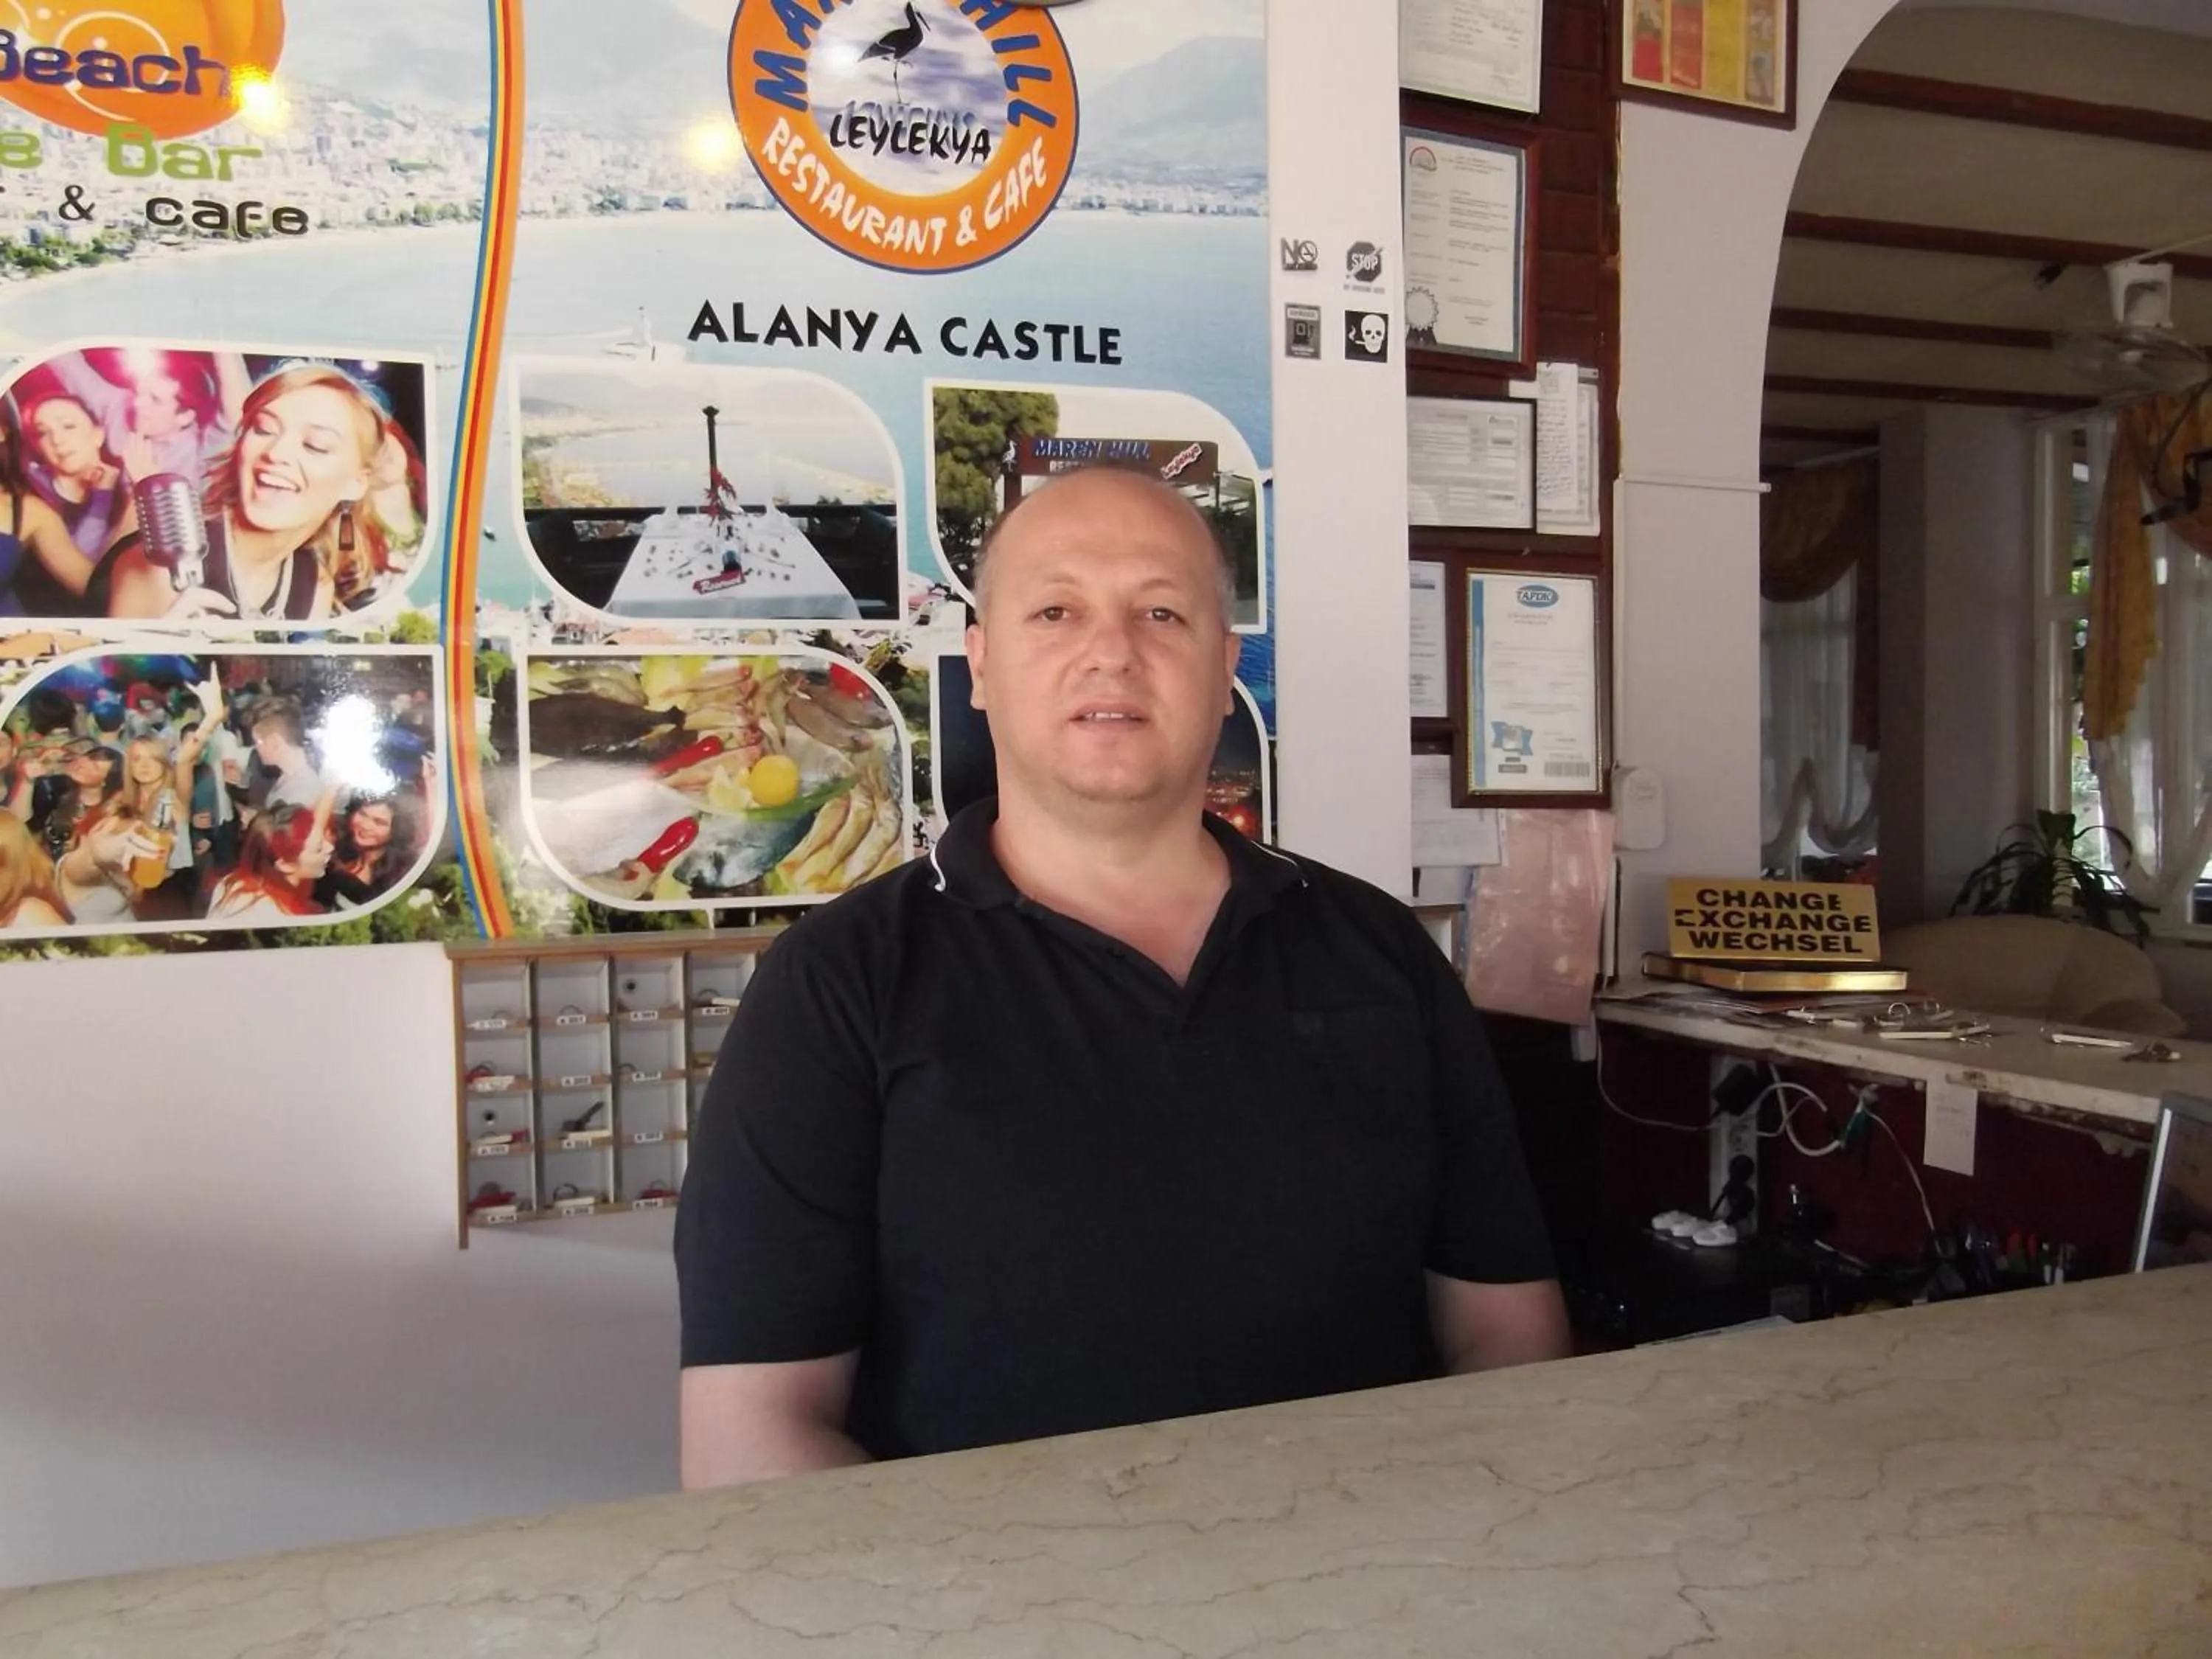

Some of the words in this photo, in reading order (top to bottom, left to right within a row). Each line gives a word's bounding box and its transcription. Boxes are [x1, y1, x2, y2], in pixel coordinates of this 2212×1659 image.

[762, 117, 947, 256] RESTAURANT
[956, 205, 978, 247] &
[984, 136, 1047, 231] CAFE
[58, 184, 95, 221] &
[146, 197, 309, 240] cafe
[1352, 253, 1378, 271] STOP
[687, 299, 922, 354] ALANYA
[939, 316, 1122, 365] CASTLE
[1697, 888, 1841, 911] CHANGE
[1674, 908, 1871, 933] EXCHANGE
[1688, 931, 1863, 953] WECHSEL
